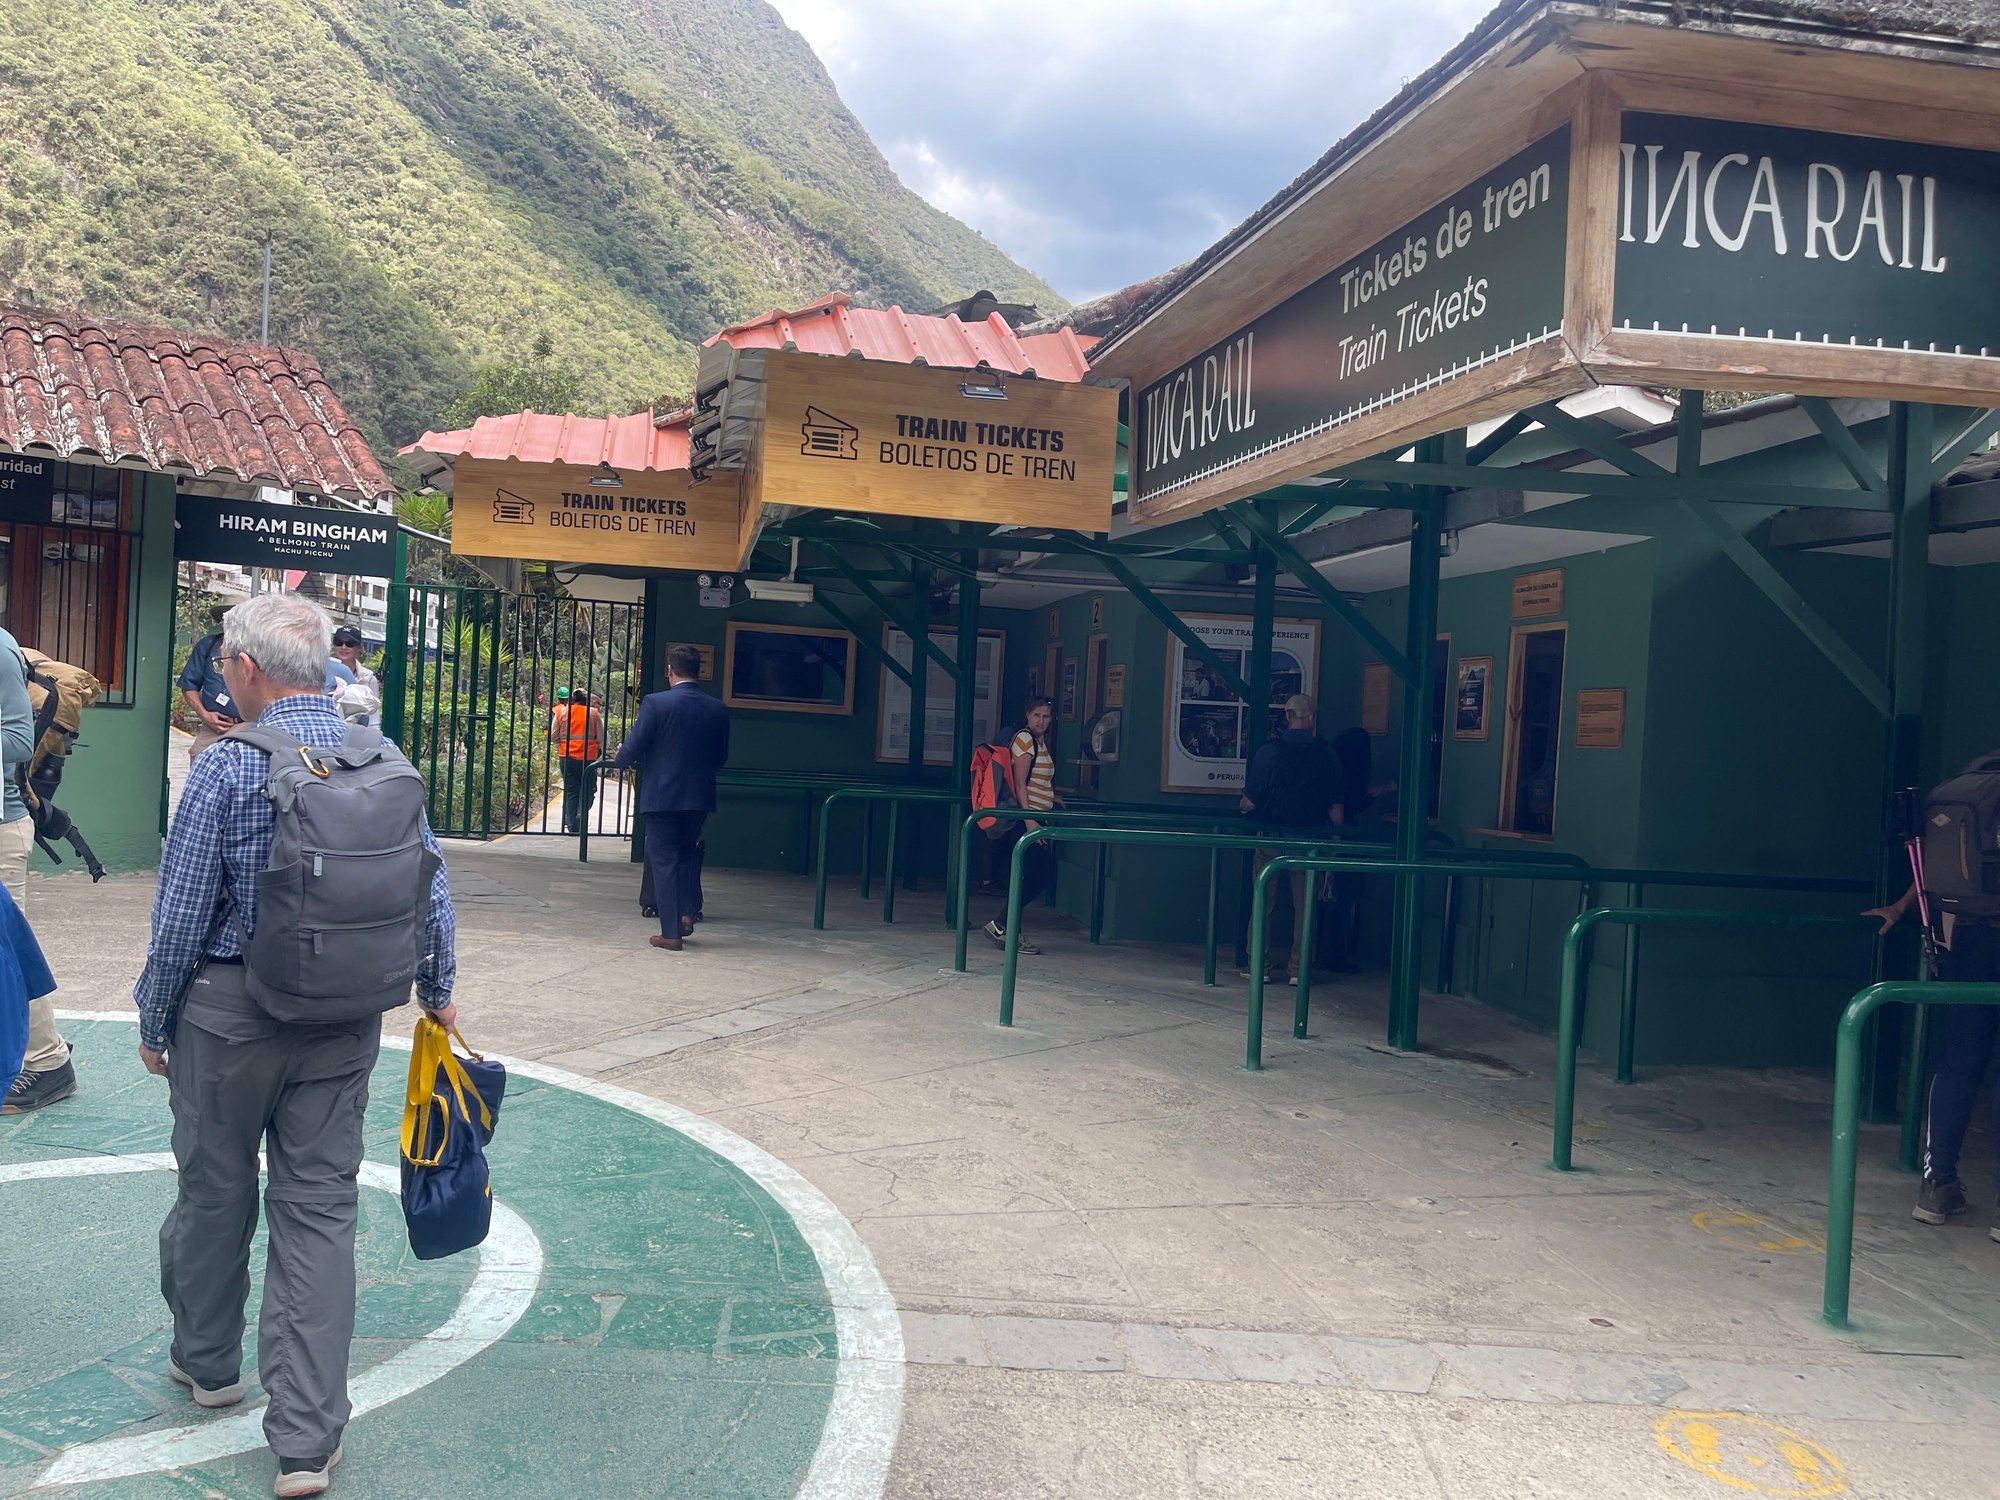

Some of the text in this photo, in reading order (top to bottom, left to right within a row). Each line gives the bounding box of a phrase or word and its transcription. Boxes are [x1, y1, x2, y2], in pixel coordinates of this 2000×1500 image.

[1619, 143, 1945, 273] INCA RAIL
[1340, 163, 1550, 314] Tickets de tren
[1339, 275, 1488, 381] Train Tickets
[1145, 331, 1256, 472] INCA RAIL
[896, 414, 1064, 453] TRAIN TICKETS
[879, 441, 1076, 482] BOLETOS DE TREN
[561, 492, 687, 516] TRAIN TICKETS
[219, 514, 387, 545] HIRAM BINGHAM
[550, 511, 696, 536] BOLETOS DE TREN
[269, 537, 317, 548] BELMOND
[321, 541, 351, 551] TRAIN
[274, 547, 334, 558] MACHU PICCHU
[1093, 601, 1100, 624] 2
